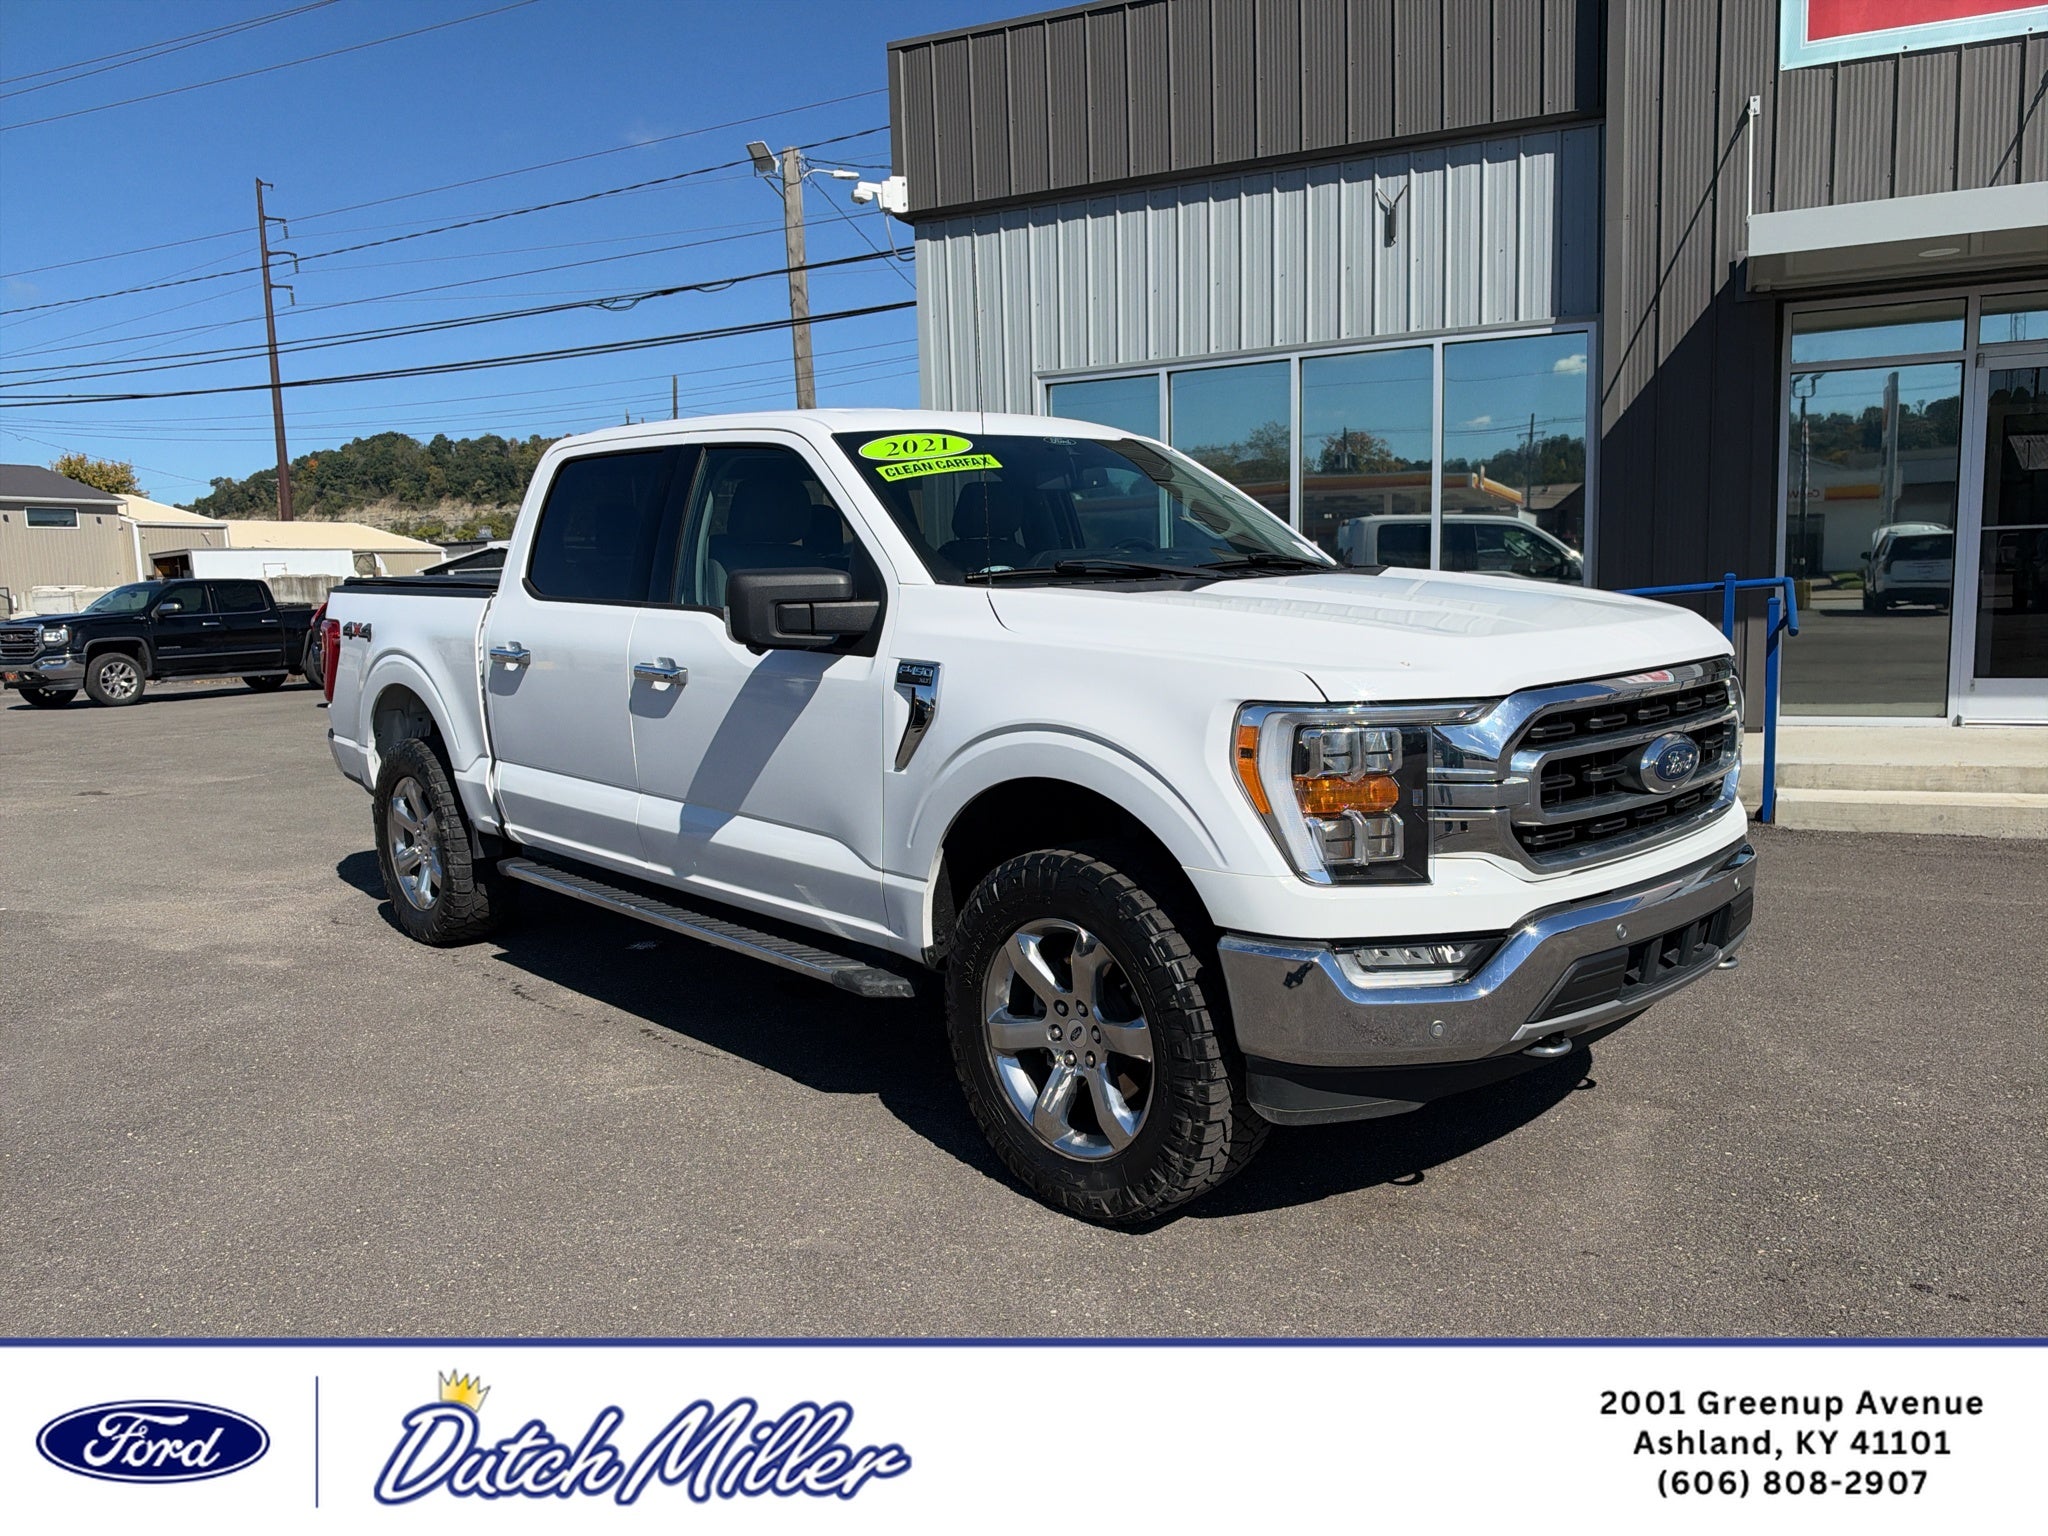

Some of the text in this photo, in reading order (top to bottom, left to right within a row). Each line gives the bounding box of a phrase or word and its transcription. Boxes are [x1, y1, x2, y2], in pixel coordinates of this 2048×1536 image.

[884, 437, 950, 457] 2021
[884, 456, 991, 478] CLEAN CARFAX
[1665, 750, 1693, 777] Ford
